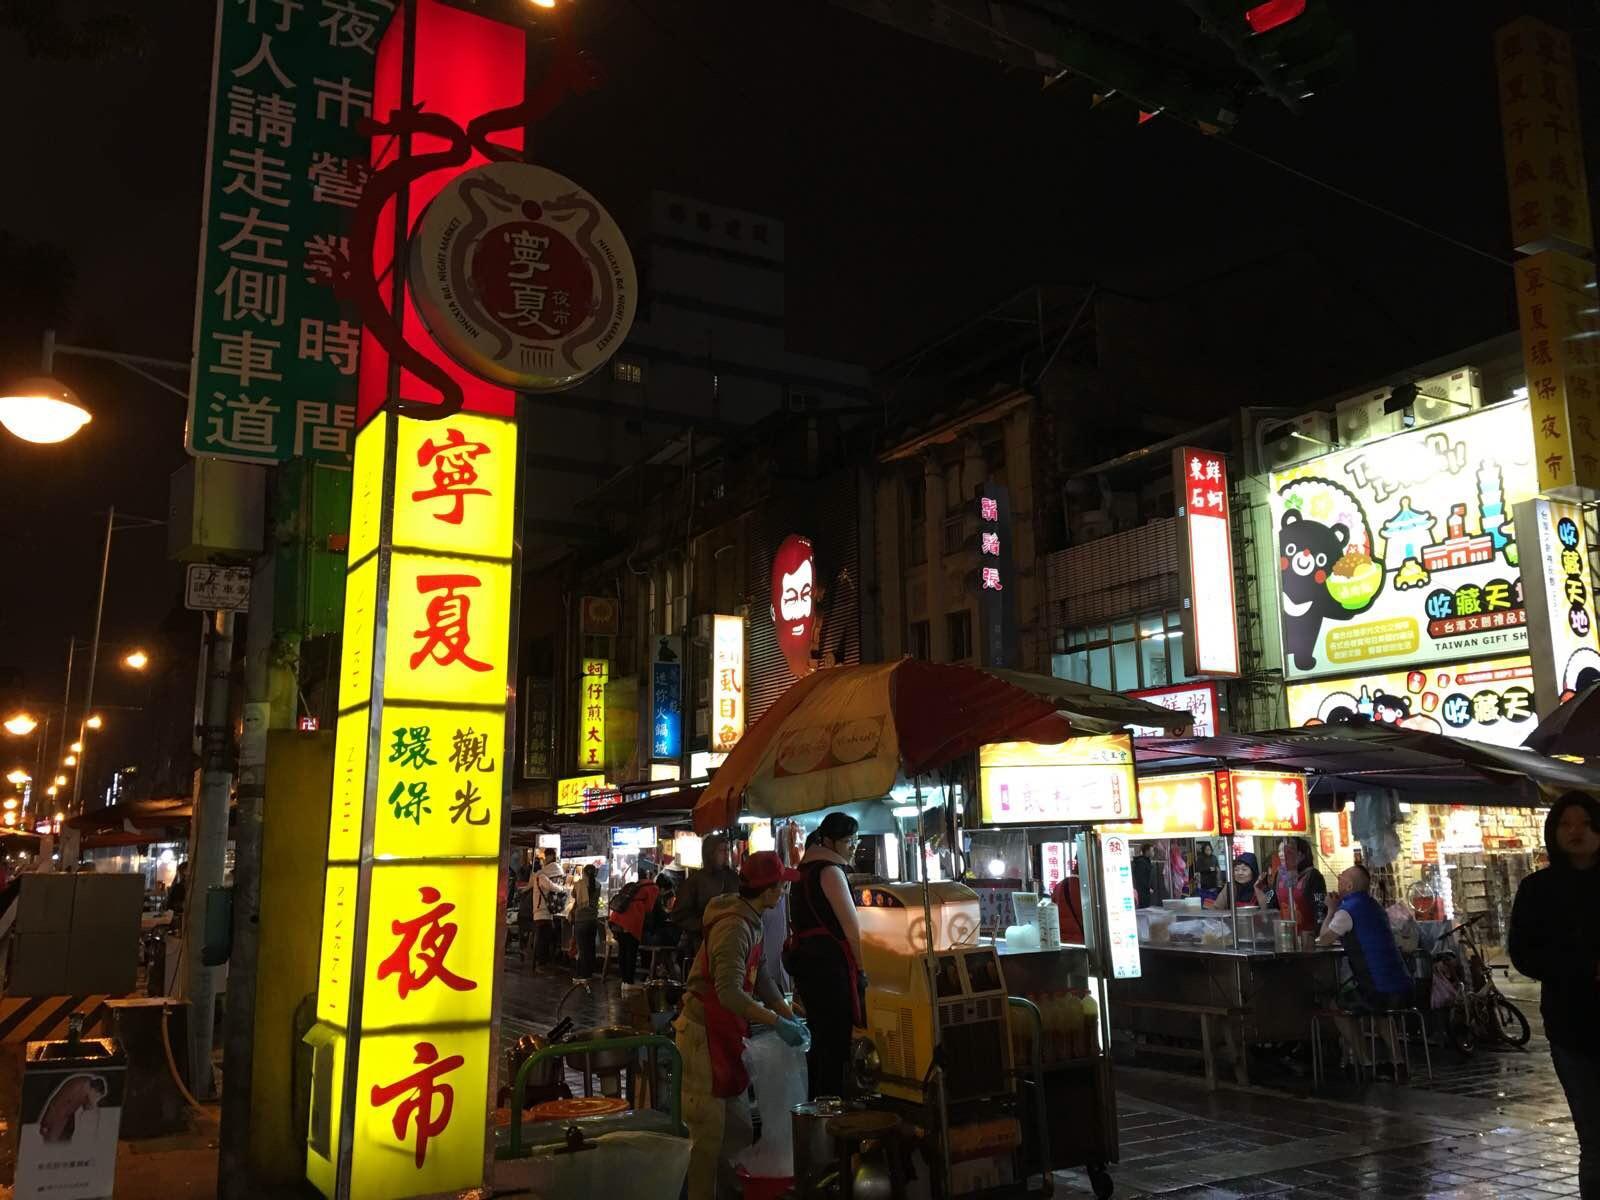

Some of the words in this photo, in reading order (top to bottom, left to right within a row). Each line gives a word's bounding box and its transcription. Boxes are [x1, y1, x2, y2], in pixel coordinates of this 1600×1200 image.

[437, 252, 447, 282] NIGHT
[439, 216, 463, 251] MARKET
[498, 229, 561, 336] 寧夏
[1189, 456, 1206, 508] 東石
[410, 428, 494, 672] 寧夏
[1435, 638, 1479, 651] TAIWAN
[1482, 634, 1508, 645] GIFT
[586, 661, 604, 765] 蚵仔煎大王
[387, 725, 437, 826] 環保
[447, 728, 494, 826] 觀光
[371, 886, 477, 1169] 夜市
